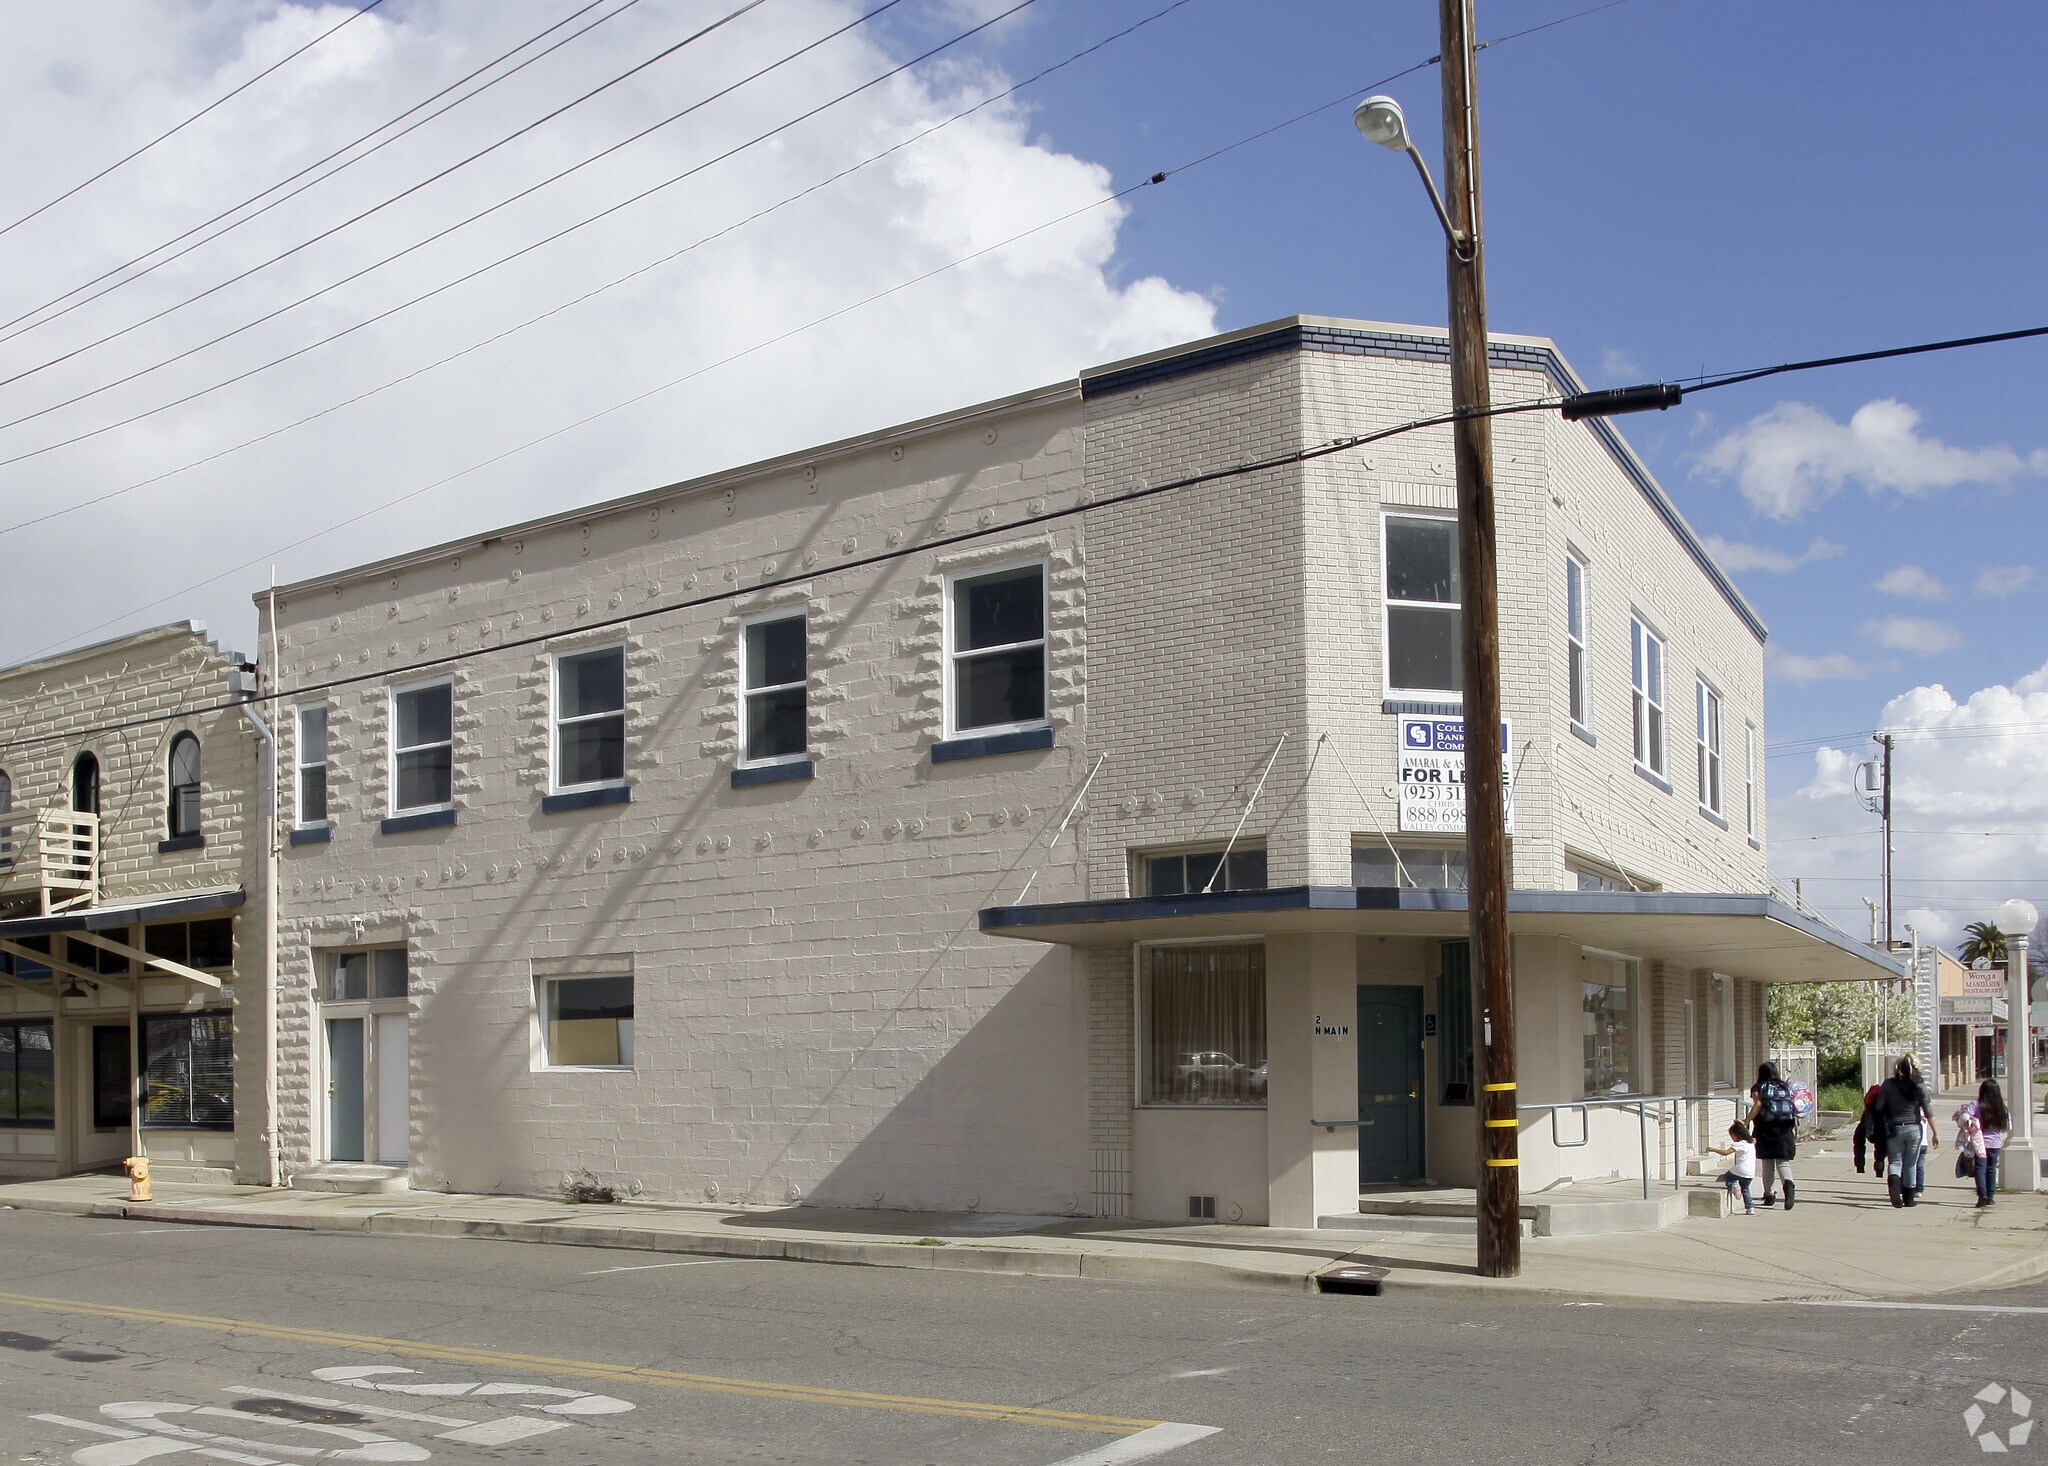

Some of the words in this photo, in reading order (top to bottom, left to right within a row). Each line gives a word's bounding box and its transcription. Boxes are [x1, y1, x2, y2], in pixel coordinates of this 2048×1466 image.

[1436, 732, 1464, 741] BANK
[1404, 757, 1440, 768] AMARAL
[1443, 758, 1451, 769] &
[1403, 768, 1441, 783] FOR
[1404, 784, 1440, 801] (925)
[1428, 800, 1455, 808] CHRIS
[1406, 806, 1437, 823] (888)
[1315, 1015, 1321, 1024] 2
[1315, 1026, 1321, 1035] N
[1324, 1026, 1348, 1035] MAIN
